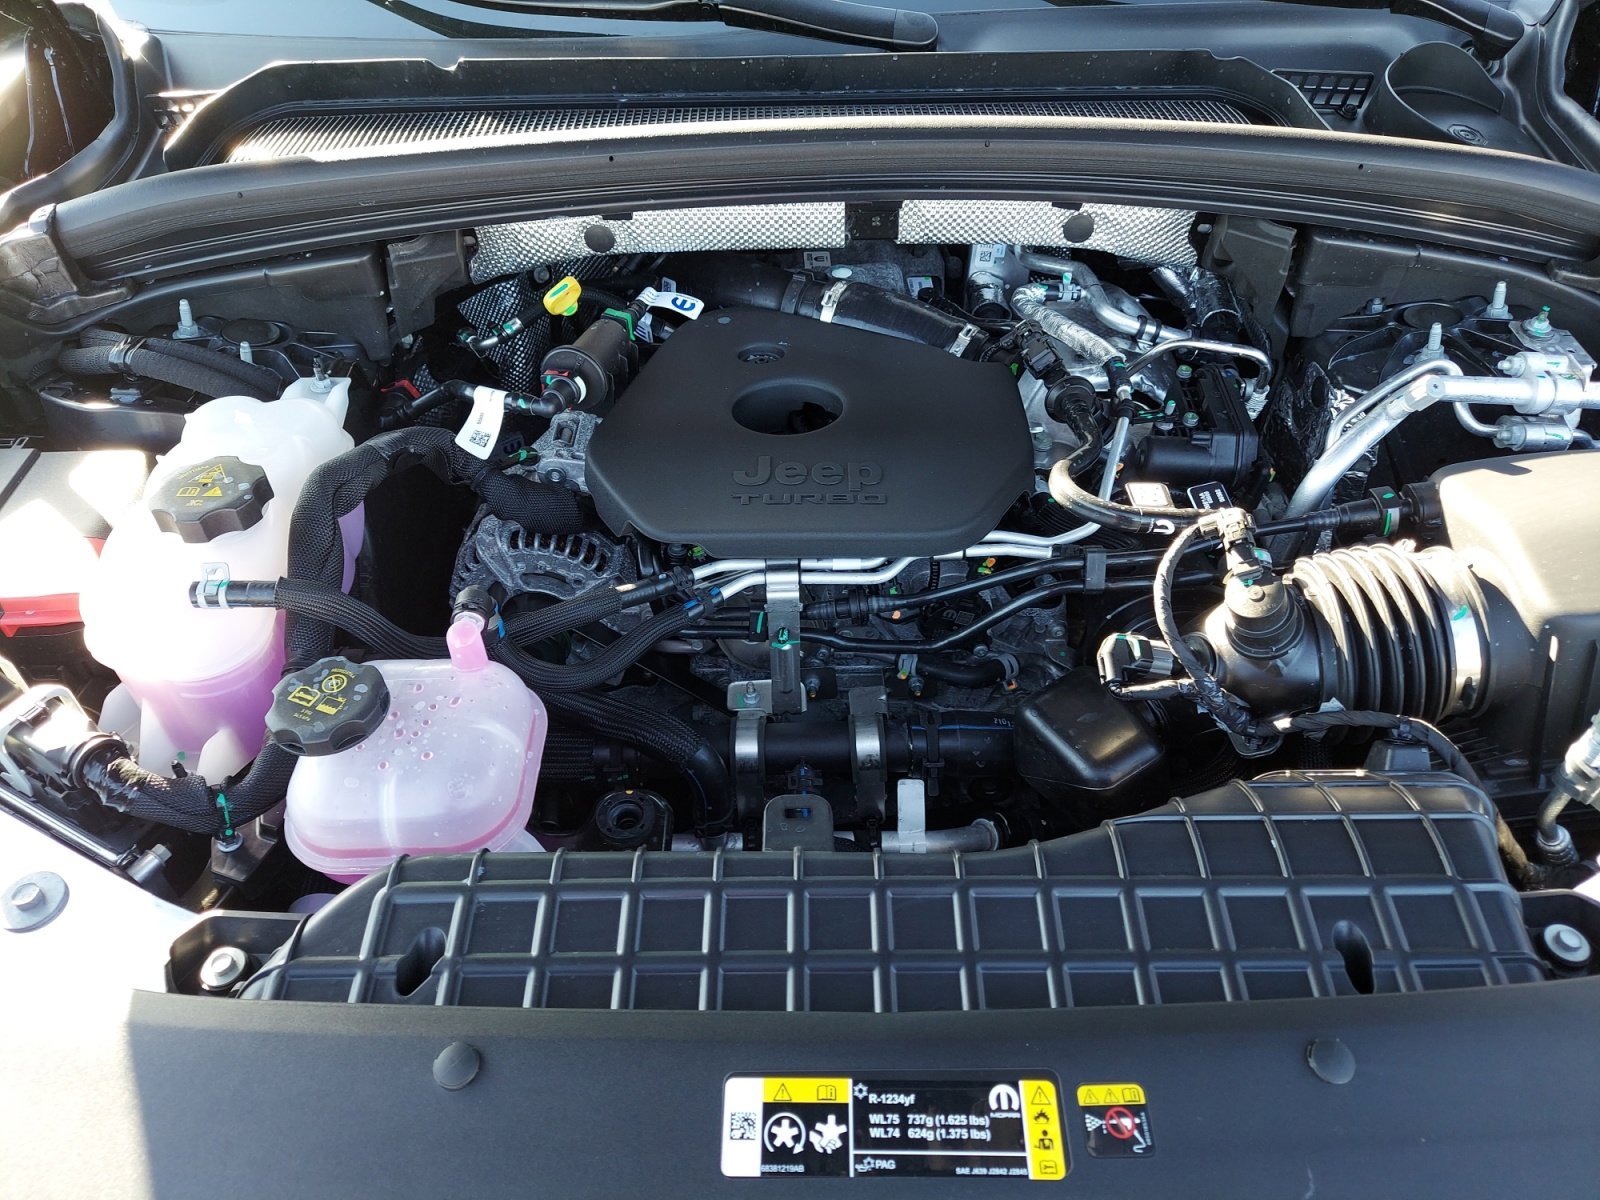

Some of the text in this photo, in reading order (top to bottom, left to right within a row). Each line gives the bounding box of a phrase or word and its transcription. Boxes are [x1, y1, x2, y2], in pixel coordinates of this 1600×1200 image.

[733, 455, 883, 492] Jeep
[732, 493, 887, 505] TURBO
[869, 1093, 916, 1107] R-1234yf
[869, 1114, 990, 1128] WL75 737g (1.625 lbs)
[869, 1127, 991, 1141] WL74 624g (1.375 lbs)
[875, 1159, 896, 1169] PAG
